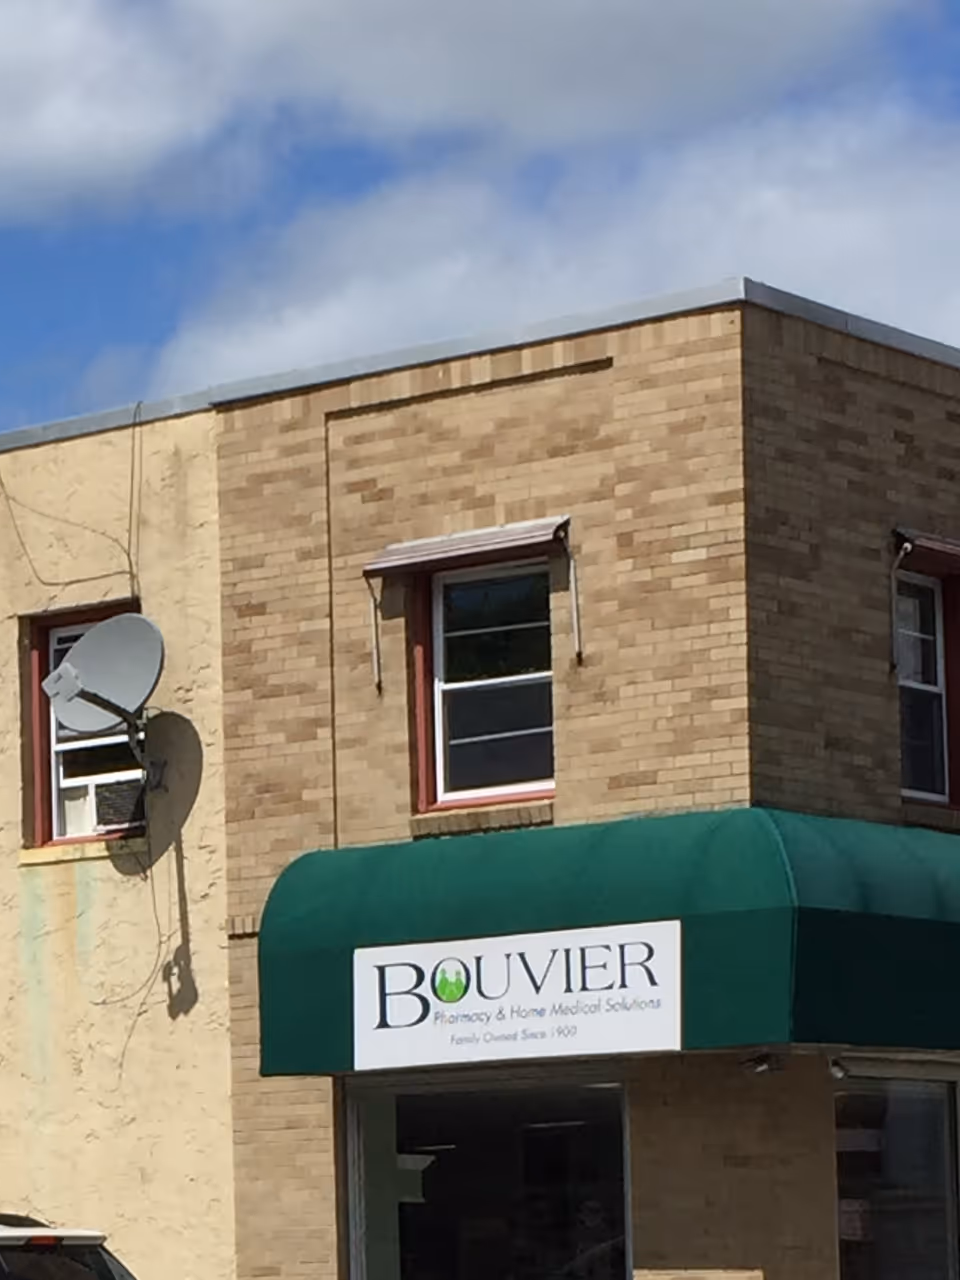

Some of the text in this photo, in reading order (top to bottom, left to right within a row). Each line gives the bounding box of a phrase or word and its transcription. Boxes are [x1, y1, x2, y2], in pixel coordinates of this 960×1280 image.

[373, 941, 659, 1030] BOUVIER
[433, 997, 661, 1026] Pharmacy & Home Medical Solutions
[451, 1025, 577, 1045] Family Owned Since 1900
